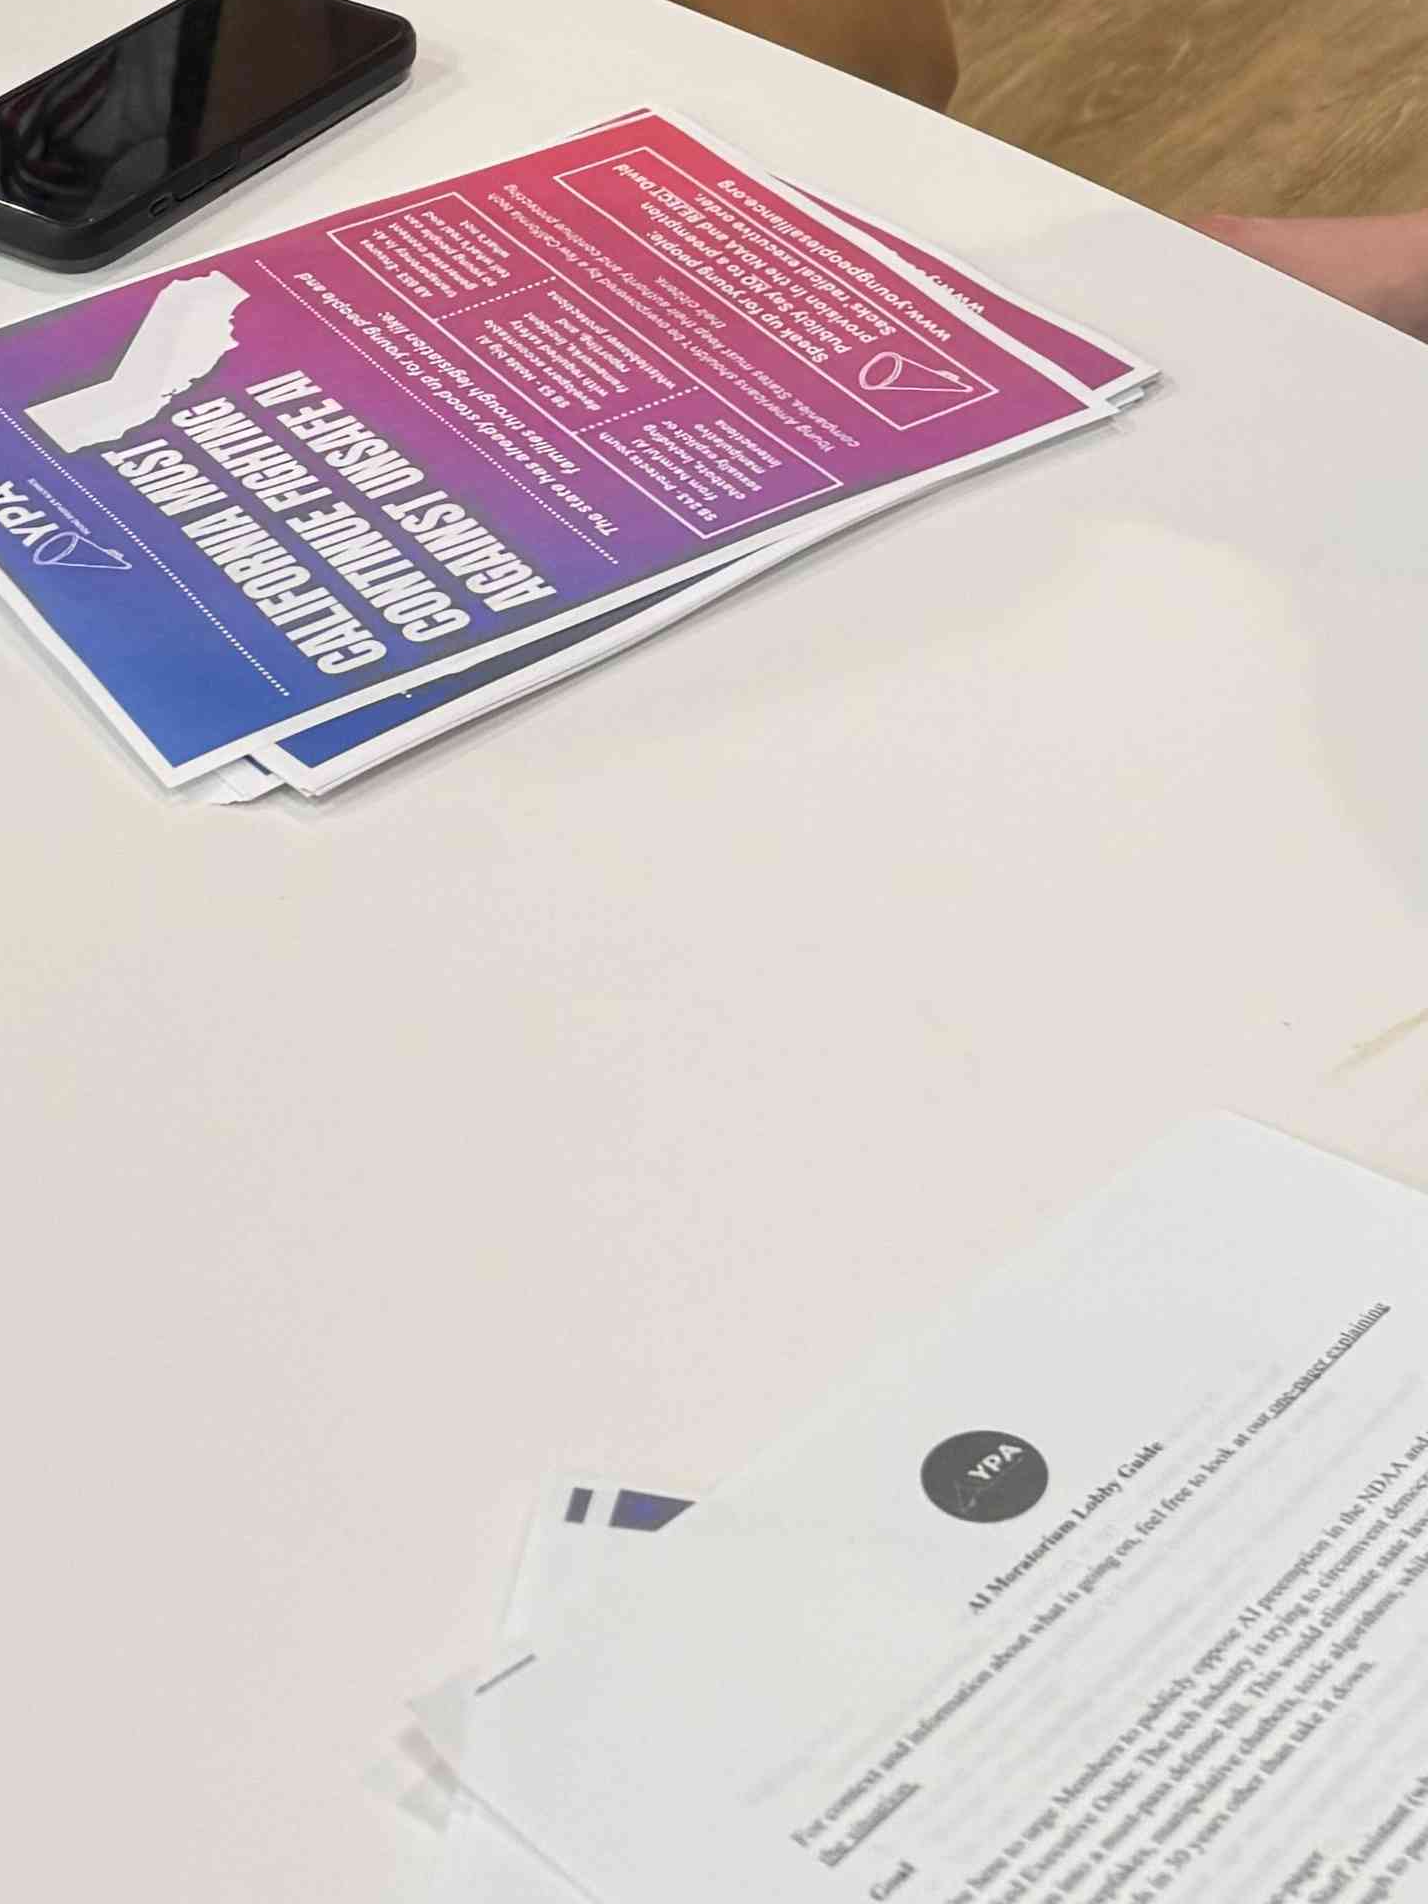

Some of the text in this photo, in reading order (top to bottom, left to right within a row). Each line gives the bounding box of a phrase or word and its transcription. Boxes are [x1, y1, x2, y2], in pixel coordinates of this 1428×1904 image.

[611, 163, 880, 344] provision in the NDAA and REJECT David
[687, 193, 737, 223] order.
[711, 179, 959, 341] www.youngpeoplesalliance.org
[727, 221, 802, 268] executive
[634, 200, 856, 353] Publicly Say NO to a preemption
[641, 228, 835, 363] Speak up for young people:
[792, 266, 851, 302] radical
[292, 271, 621, 536] The state has already stood up for young people and
[370, 310, 582, 476] families through legislation like:
[594, 430, 637, 457] youth
[661, 418, 766, 492] sexually explicit or
[690, 421, 769, 475] manipulative
[711, 418, 783, 467] interactions
[172, 397, 470, 641] CONTINUE FIGHTING
[246, 371, 556, 611] AGAINST UNSAFE AI
[625, 454, 679, 491] Protects
[630, 437, 719, 501] from harmful AI
[638, 423, 751, 501] chatbots, including
[694, 507, 719, 522] SB
[101, 439, 386, 673] CALIFORNIA MUST
[962, 1439, 1167, 1614] AI Moratorium Lobby Guide
[968, 1444, 1023, 1480] YPA
[788, 1299, 1394, 1848] For context and information about what is going on, feel free to look at our one-pager explaining
[964, 1852, 1011, 1891] here
[999, 1837, 1026, 1857] to
[1020, 1807, 1064, 1843] urge
[1050, 1740, 1127, 1809] Members
[1116, 1725, 1142, 1745] to
[1131, 1673, 1198, 1731] publicly
[1190, 1626, 1247, 1677] oppose
[1232, 1605, 1262, 1628] AI
[1251, 1535, 1336, 1611] preemption
[1321, 1521, 1346, 1540] in
[1335, 1500, 1367, 1525] the
[1356, 1458, 1409, 1504] NDAA
[1018, 1809, 1099, 1883] Executive
[1089, 1766, 1143, 1813] Order.
[1135, 1736, 1173, 1767] The
[1162, 1707, 1203, 1741] tech
[1192, 1653, 1260, 1713] industry
[1245, 1639, 1269, 1656] is
[1258, 1600, 1312, 1645] trying
[1297, 1584, 1323, 1603] to
[1311, 1517, 1389, 1589] circumvent
